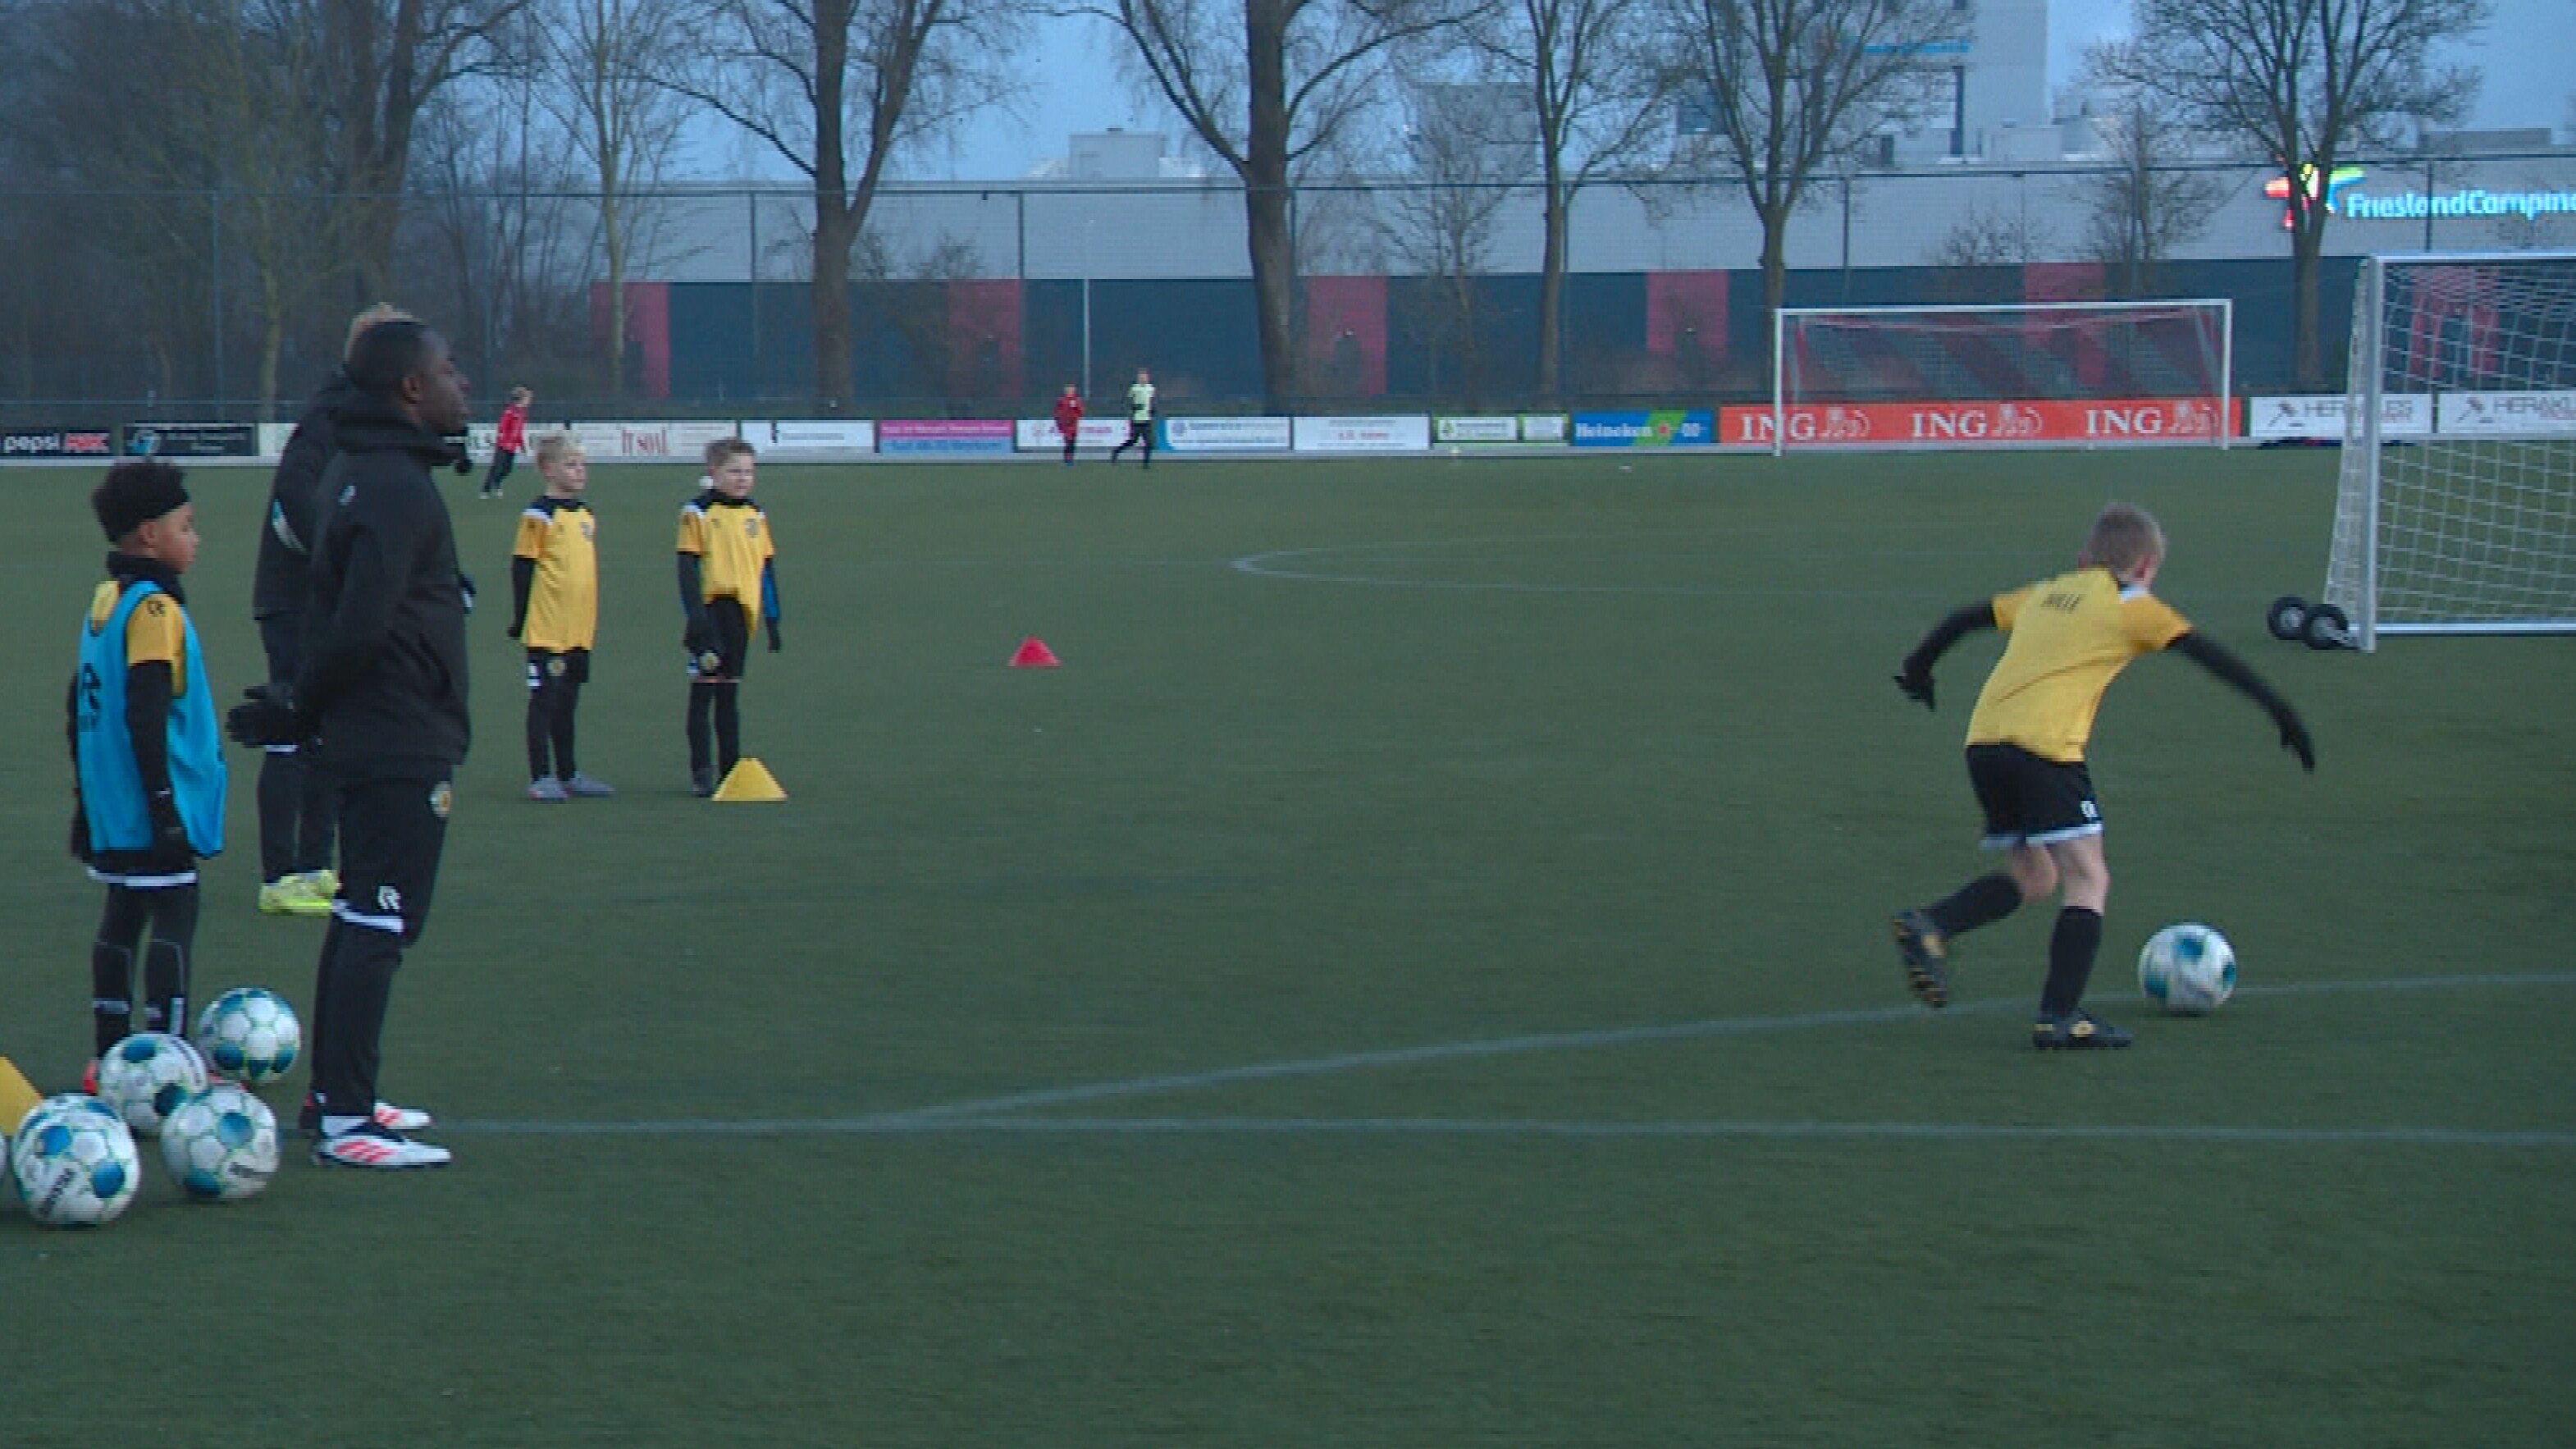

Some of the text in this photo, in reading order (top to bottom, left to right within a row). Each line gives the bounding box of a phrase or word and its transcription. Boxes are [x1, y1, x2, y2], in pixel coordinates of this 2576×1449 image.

[1575, 423, 1653, 437] Heineken
[1741, 412, 1816, 440] ING
[1912, 409, 1987, 437] ING
[2086, 408, 2163, 435] ING
[4, 432, 60, 453] pepsi
